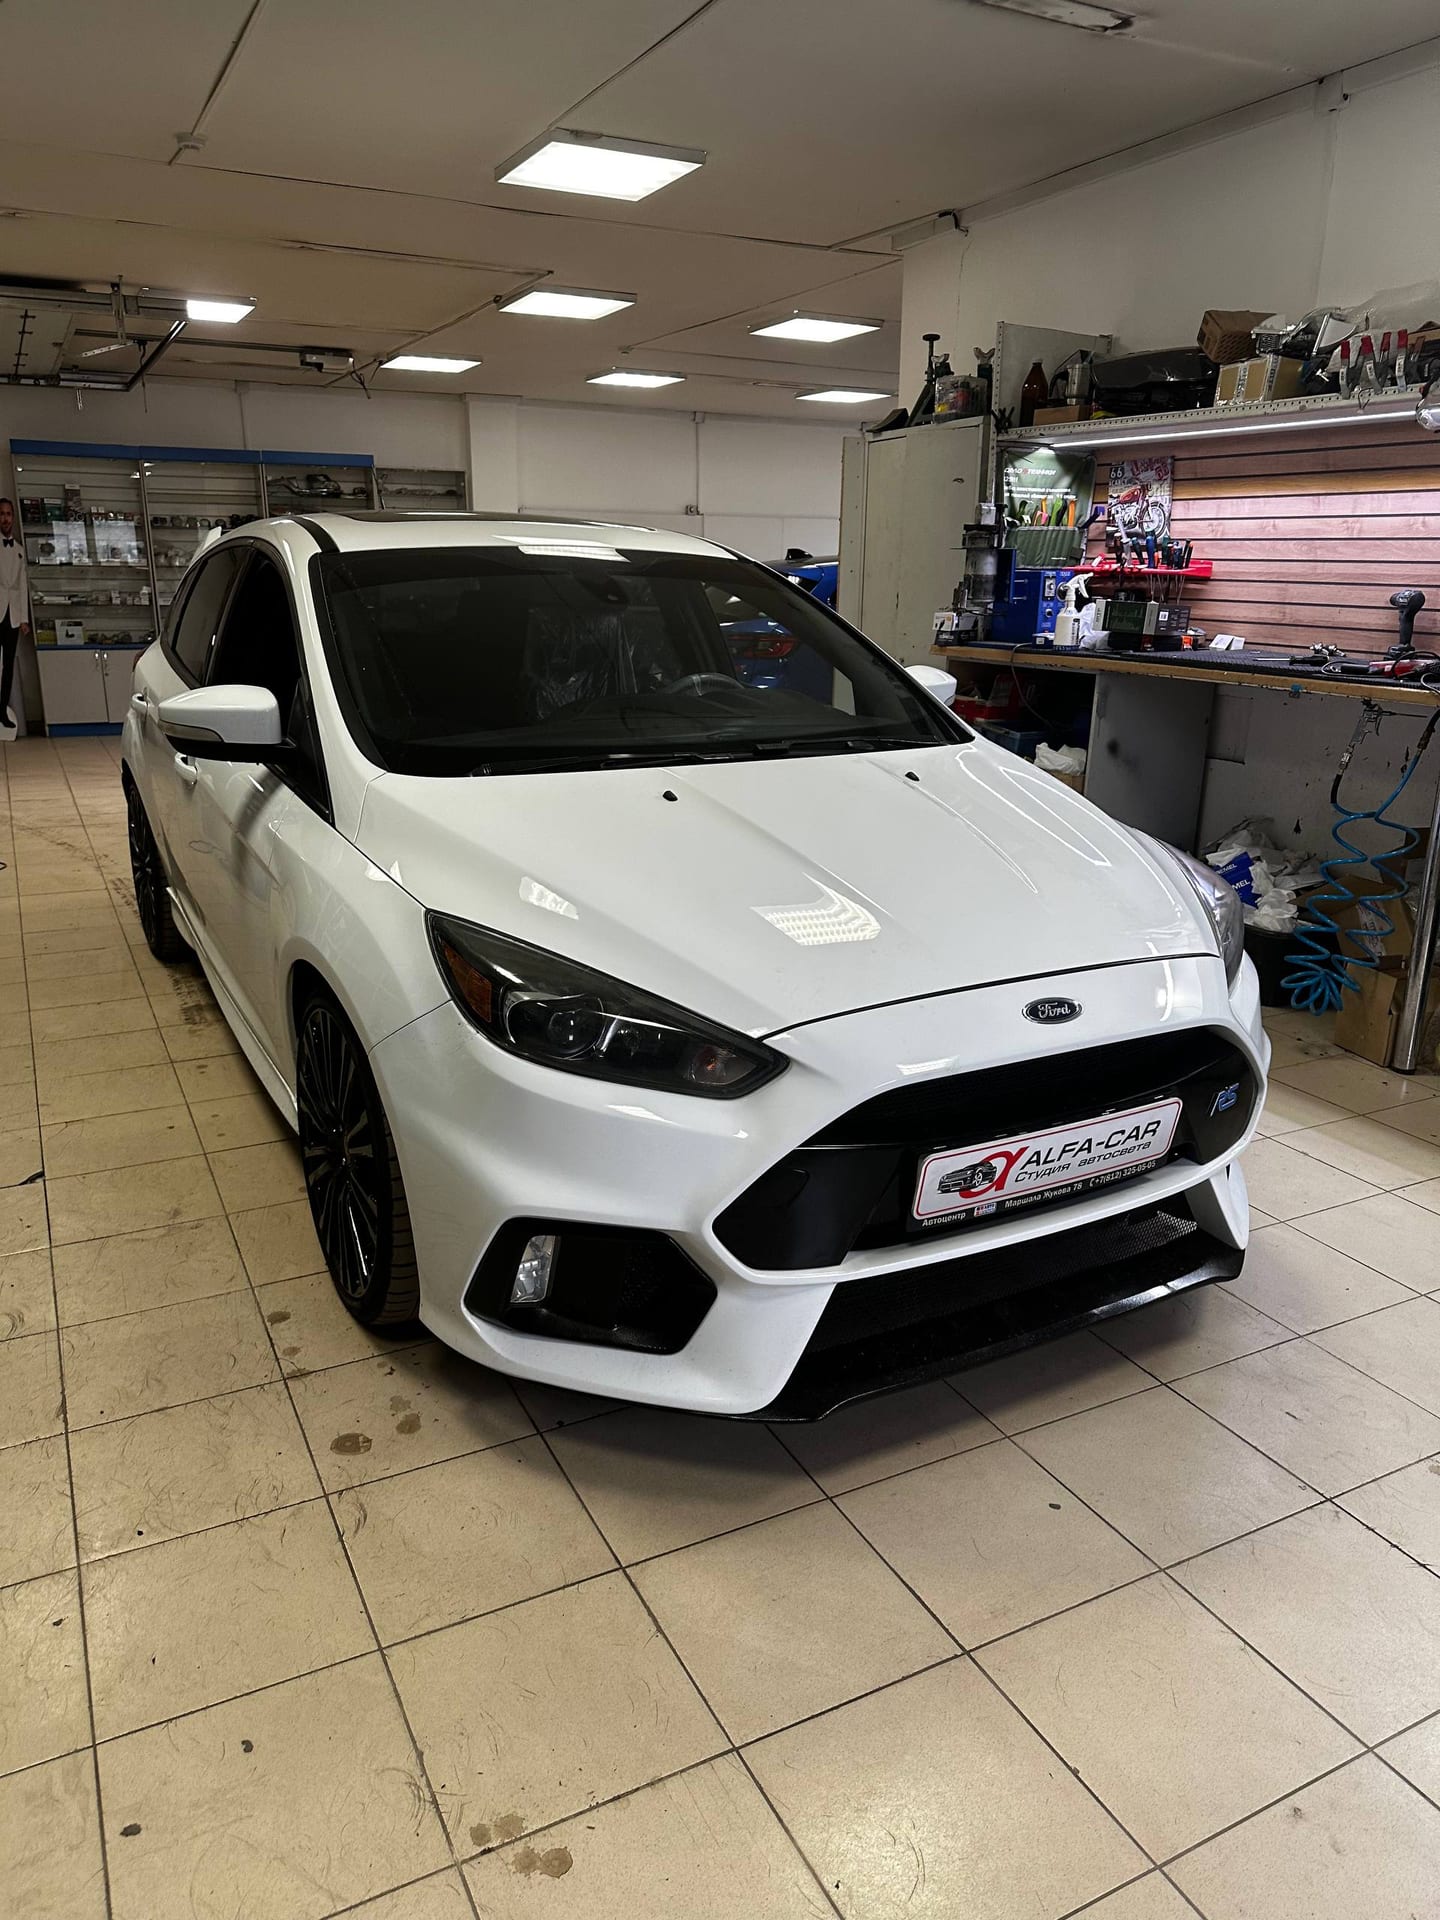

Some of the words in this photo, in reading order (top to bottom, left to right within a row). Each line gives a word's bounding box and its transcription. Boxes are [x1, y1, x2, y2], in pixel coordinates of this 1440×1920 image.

[1037, 1002, 1071, 1019] Ford
[1020, 1119, 1162, 1170] ALFA-CAR
[1014, 1162, 1071, 1183] Студия
[1078, 1141, 1152, 1167] автосвета
[922, 1212, 966, 1227] Автоцентр
